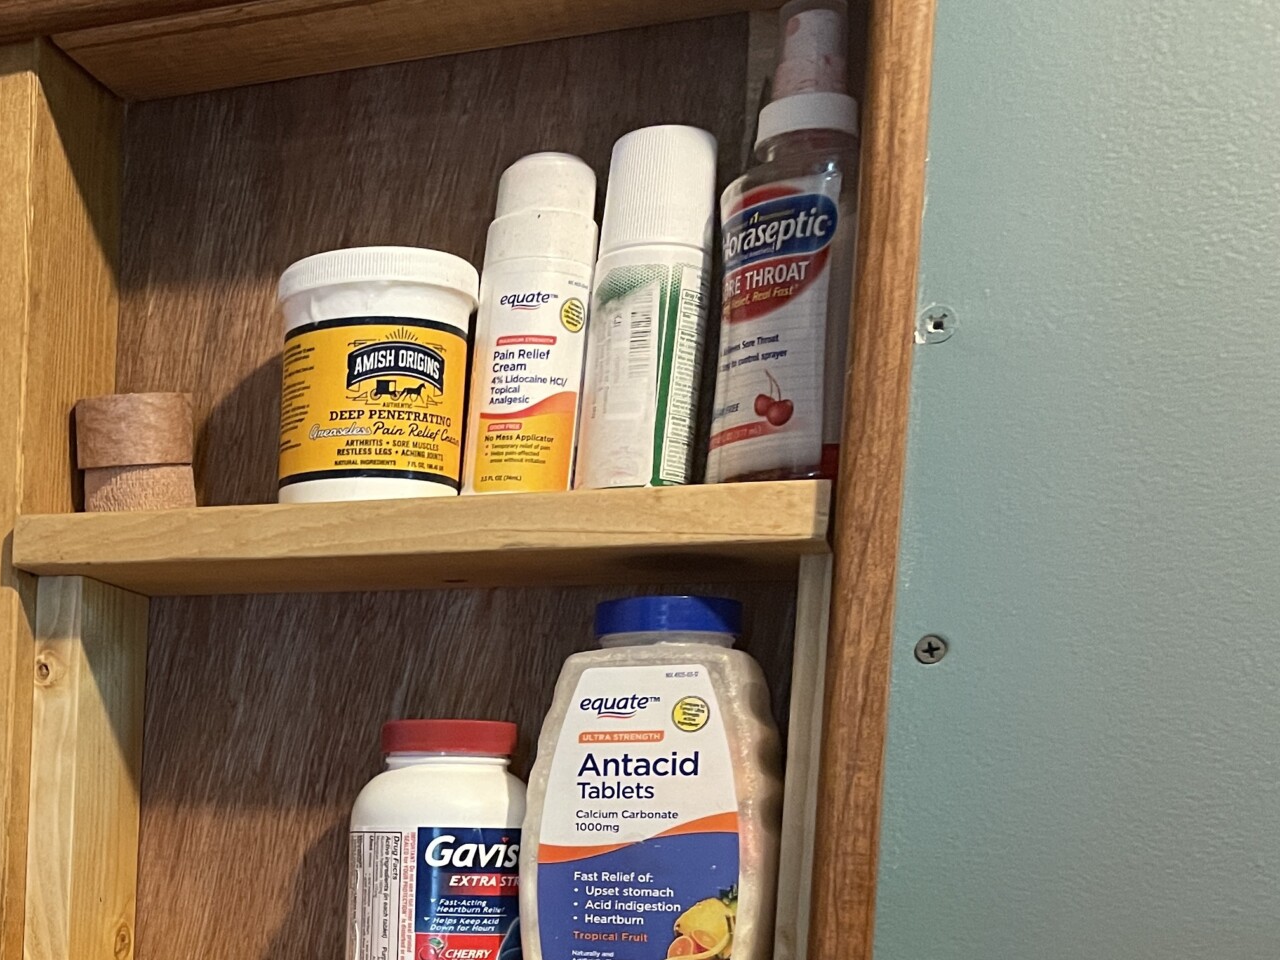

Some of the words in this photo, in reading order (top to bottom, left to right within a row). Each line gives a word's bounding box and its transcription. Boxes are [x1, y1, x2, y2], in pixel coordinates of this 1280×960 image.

[745, 261, 809, 290] THROAT
[742, 340, 755, 349] Sore
[757, 334, 779, 345] Throat
[493, 350, 515, 361] Pain
[517, 349, 550, 360] Relief
[354, 350, 395, 375] AMISH
[398, 350, 440, 379] ORIGINS
[492, 362, 526, 373] Cream
[491, 375, 503, 384] 4%
[505, 375, 547, 384] Lidocaine
[490, 386, 520, 396] Topical
[489, 395, 530, 405] Analgesic
[329, 410, 365, 421] DEEP
[368, 410, 451, 427] PENETRATING
[373, 421, 405, 435] Pain
[408, 423, 440, 441] Relief
[515, 434, 554, 443] Applicator
[392, 440, 410, 448] SORE
[412, 441, 439, 451] MUSCLES
[337, 448, 372, 456] RESTLESS
[400, 449, 425, 457] ACHING
[582, 733, 610, 741] ULTRA
[613, 733, 661, 741] STRENGTH
[577, 751, 699, 777] Antacid
[577, 782, 654, 799] Tablets
[576, 810, 618, 819] Calcium
[621, 810, 679, 820] Carbonate
[575, 823, 620, 833] 1000mg
[392, 836, 400, 858] Drug
[425, 835, 520, 868] Gavis
[392, 859, 400, 880] Facts
[449, 876, 496, 887] EXTRA
[574, 872, 598, 882] Fast
[601, 872, 635, 882] Relief
[638, 872, 654, 883] of:
[585, 886, 619, 897] Upset
[622, 887, 674, 897] stomach
[438, 898, 487, 907] Fast-Acting
[585, 900, 611, 910] Acid
[615, 900, 681, 912] indigestion
[433, 917, 457, 925] Helps
[585, 914, 644, 925] Heartburn
[573, 931, 618, 942] Tropical
[621, 931, 648, 942] Fruit
[445, 949, 492, 959] CHERRY
